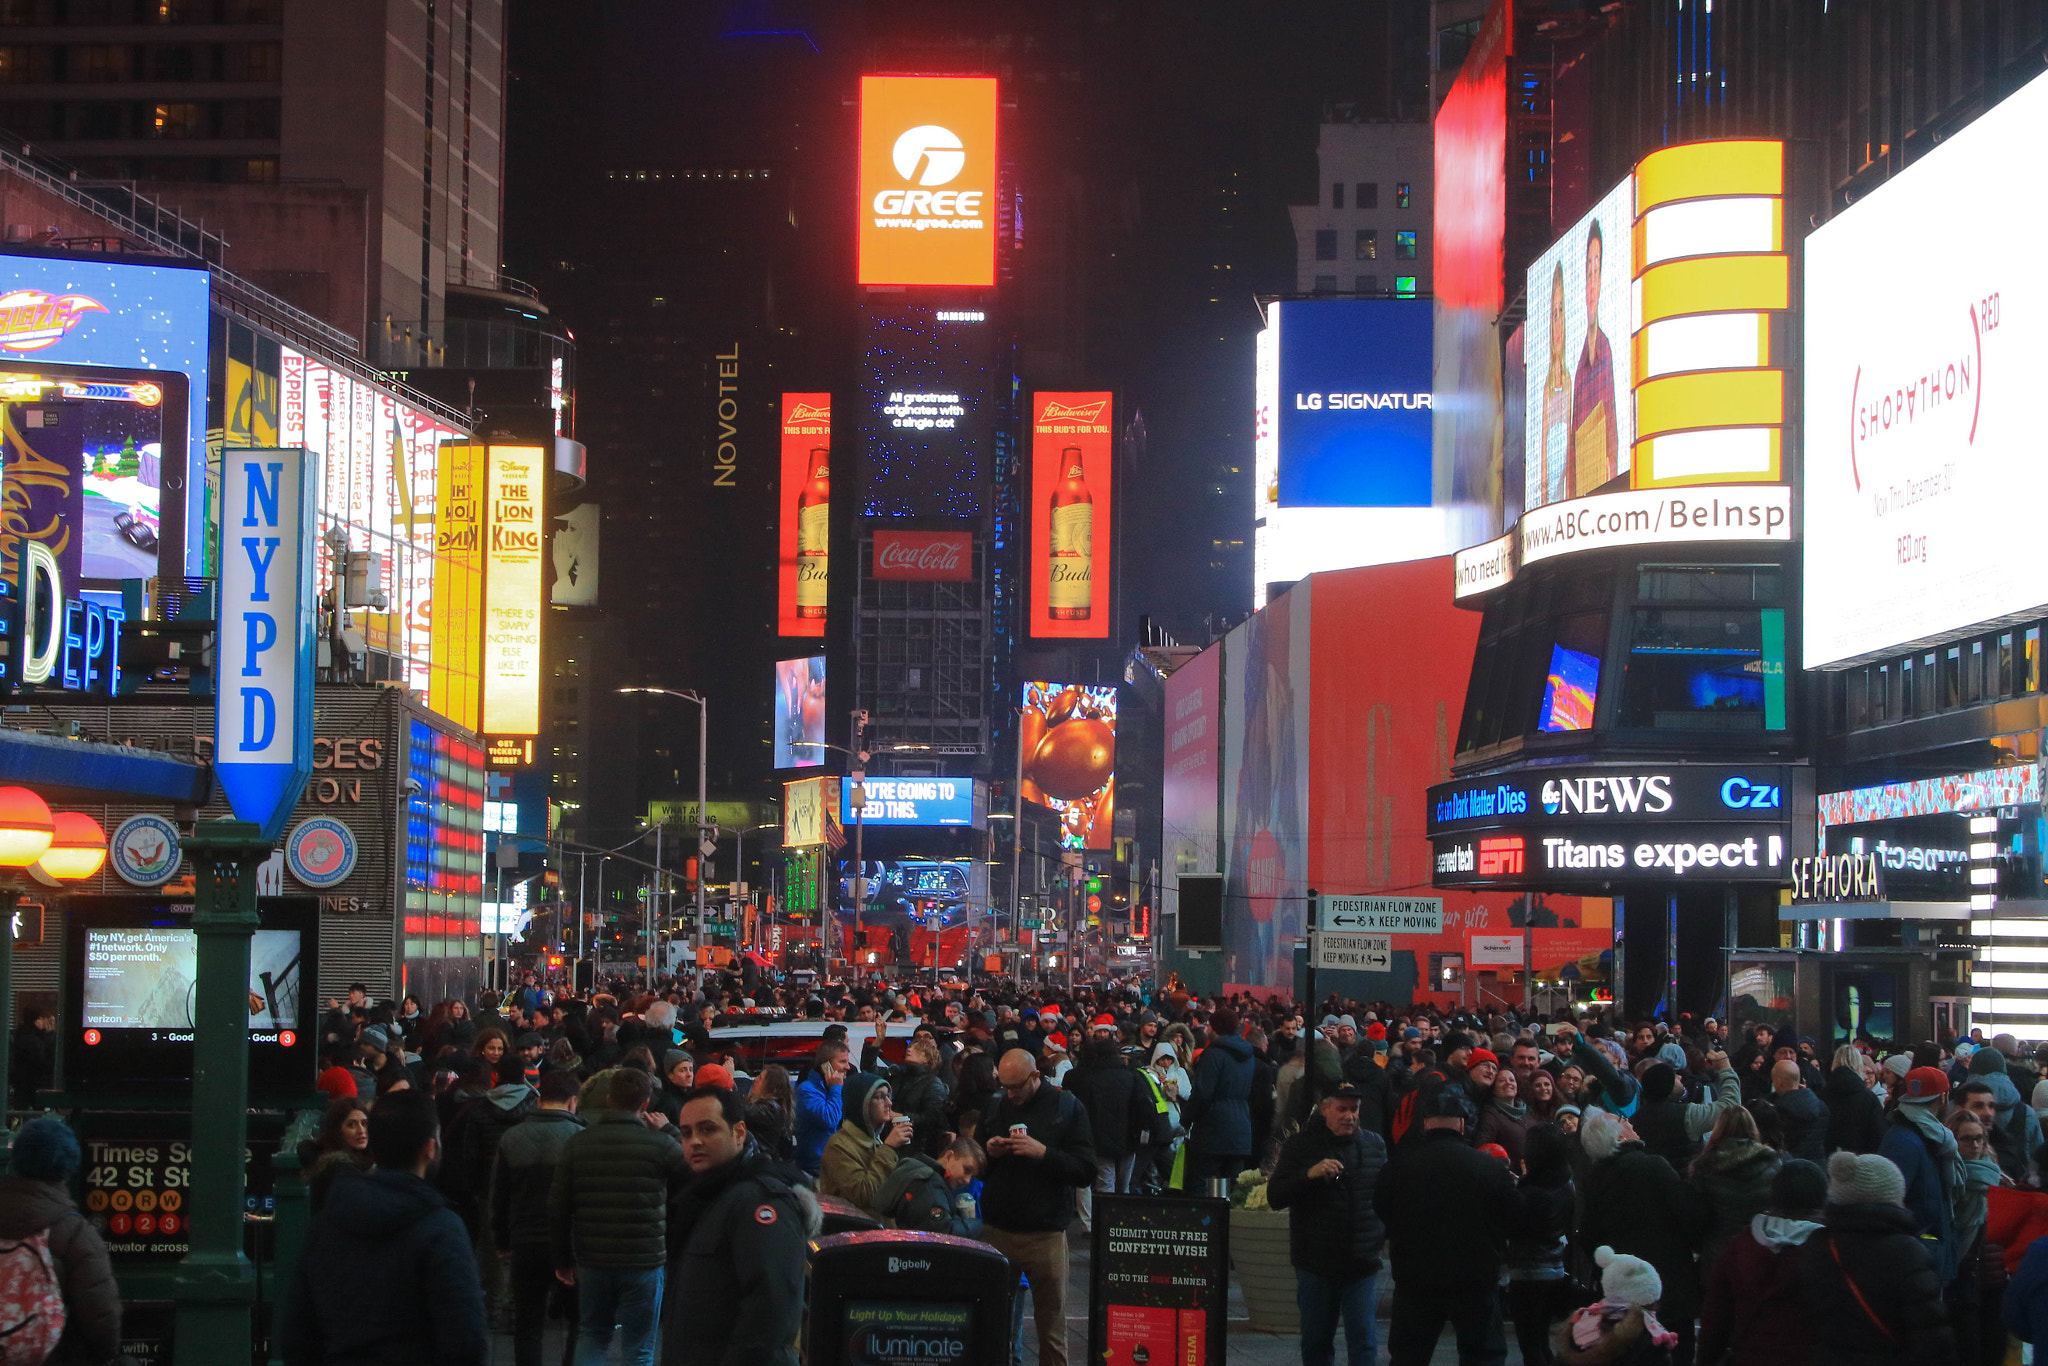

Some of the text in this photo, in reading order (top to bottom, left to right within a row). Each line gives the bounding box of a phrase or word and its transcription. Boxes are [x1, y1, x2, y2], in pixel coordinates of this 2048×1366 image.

[873, 190, 984, 216] GREE
[875, 218, 984, 231] www.gree.com
[936, 311, 985, 322] SAMSUNG
[1981, 291, 2000, 334] RED
[282, 356, 305, 432] EXPRESS
[889, 392, 959, 405] All greatness
[1296, 393, 1322, 410] LG
[713, 342, 739, 487] NOVOTEL
[883, 405, 965, 417] originates with
[1047, 405, 1099, 418] Budweiser
[783, 426, 824, 434] THIS BUD'S
[892, 417, 955, 430] a single dot
[1036, 425, 1110, 434] THIS BUD'S FOR YOU.
[498, 460, 530, 474] Disney
[500, 484, 528, 498] THE
[495, 500, 533, 523] LION
[491, 524, 539, 552] KING
[1897, 533, 1927, 565] RED.org
[1458, 547, 1500, 587] who need
[237, 462, 284, 752] NYPD
[526, 608, 535, 619] IS
[23, 540, 126, 697] DEPT
[499, 620, 530, 631] SIMPLY
[488, 634, 537, 645] NOTHING
[502, 646, 521, 657] ELSE
[1743, 659, 1763, 672] DICK
[497, 740, 514, 748] GET
[488, 747, 522, 756] TICKETS
[492, 756, 518, 764] HERE!
[898, 782, 937, 800] GOING
[938, 783, 955, 800] TO
[1559, 776, 1673, 815] NEWS
[1452, 790, 1469, 819] Dark
[1469, 788, 1496, 817] Matter
[1497, 785, 1527, 814] Dies
[662, 806, 688, 815] WHAT
[884, 802, 918, 819] THIS.
[689, 814, 717, 824] DONG
[291, 821, 323, 851] DEPARTMENT
[1458, 843, 1474, 872] tech
[1479, 837, 1525, 875] ESPN
[1543, 838, 1626, 869] Titans
[1633, 837, 1758, 874] expect
[1791, 852, 1878, 899] SEPHORA
[1332, 900, 1437, 914] PEDESTRIAN FLOW ZONE
[1379, 916, 1437, 928] KEEP MOVING
[1464, 904, 1489, 929] gift
[720, 924, 728, 932] 44
[89, 933, 191, 944] Hey NY, get America's
[772, 926, 783, 951] tkts
[1323, 937, 1387, 951] PEDESTRIAN FLOW ZONE
[89, 943, 168, 953] #1 network. Only
[88, 952, 162, 963] $50 per month.
[1323, 952, 1359, 964] KEEP MOVING
[88, 1014, 122, 1023] verizon
[89, 1033, 194, 1042] 3 3 Good
[252, 1033, 291, 1044] Good 3
[88, 1142, 159, 1163] Times
[86, 1166, 118, 1187] 42
[128, 1166, 154, 1187] St
[91, 1196, 273, 1208] N Q R W C E
[118, 1218, 174, 1229] 1 2 3
[1109, 1228, 1208, 1242] SUBMIT YOUR FREE
[150, 1243, 189, 1252] across
[1109, 1242, 1208, 1257] CONFETTI WISH
[888, 1256, 931, 1273] Bigbelly
[1108, 1273, 1207, 1286] GO TO THE BANNER
[850, 1309, 967, 1324] Light Up Your Holidays!
[122, 1342, 149, 1354] with
[1187, 1335, 1197, 1366] WIS
